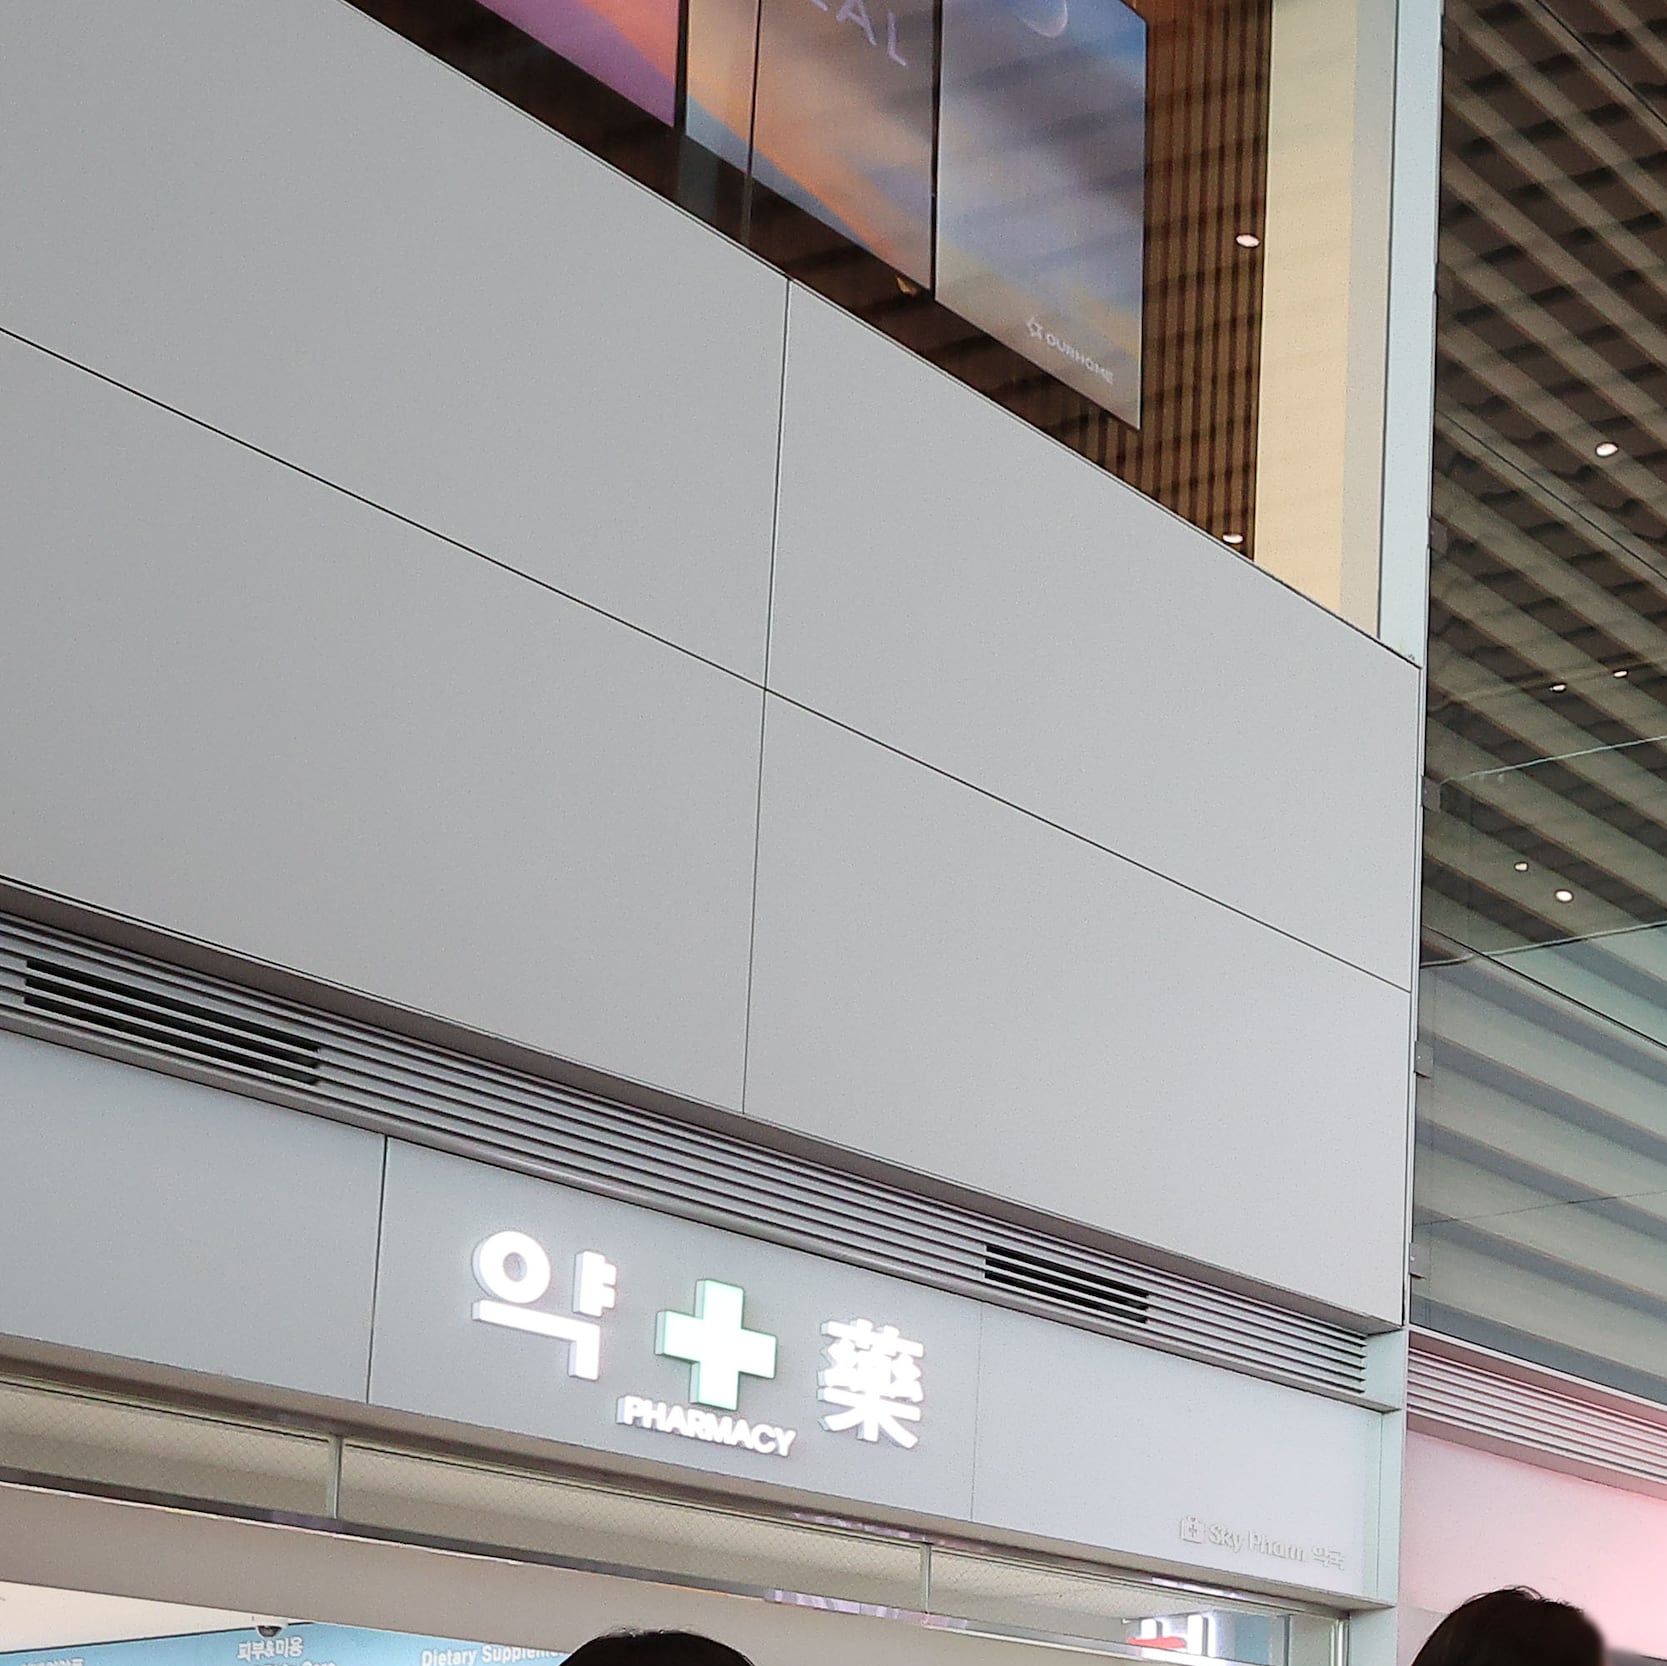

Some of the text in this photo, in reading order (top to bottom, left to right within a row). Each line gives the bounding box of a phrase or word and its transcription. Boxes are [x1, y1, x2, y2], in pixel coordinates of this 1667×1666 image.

[472, 1229, 617, 1381] 약
[817, 1317, 926, 1450] 藥
[617, 1394, 798, 1458] PHARMACY
[1208, 1523, 1242, 1553] Sky
[238, 1637, 303, 1661] 피부&미용
